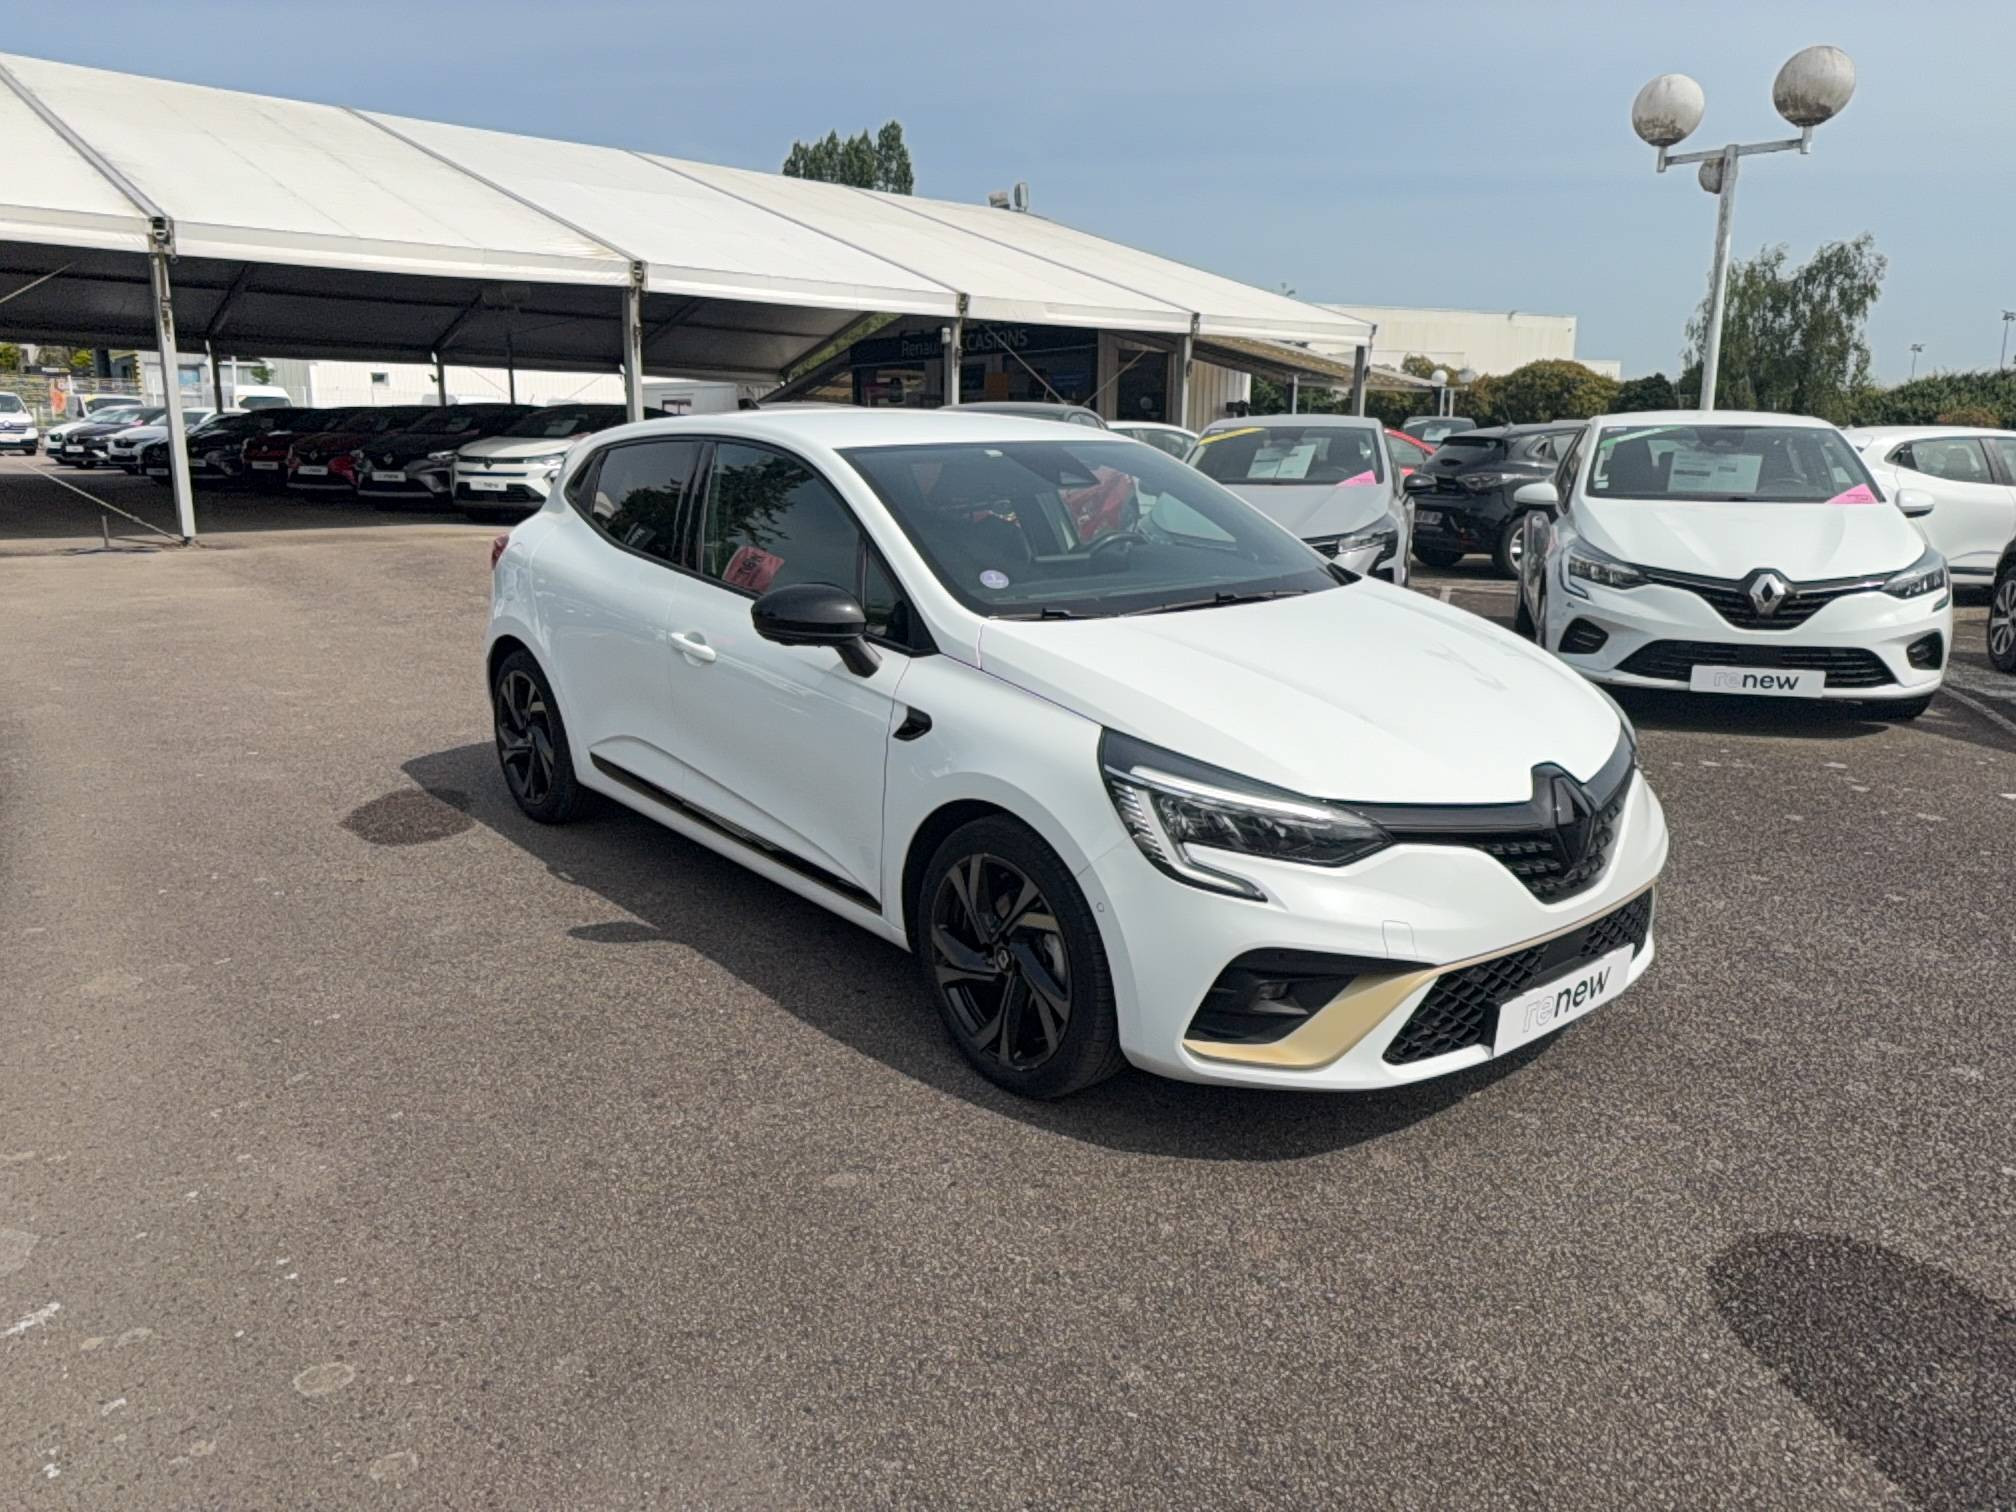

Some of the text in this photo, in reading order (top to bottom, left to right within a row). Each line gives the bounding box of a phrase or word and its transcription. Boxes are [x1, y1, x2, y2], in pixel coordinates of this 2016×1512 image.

[962, 329, 1028, 351] CASIONS
[1713, 671, 1800, 690] renew
[1522, 965, 1611, 1033] renew
